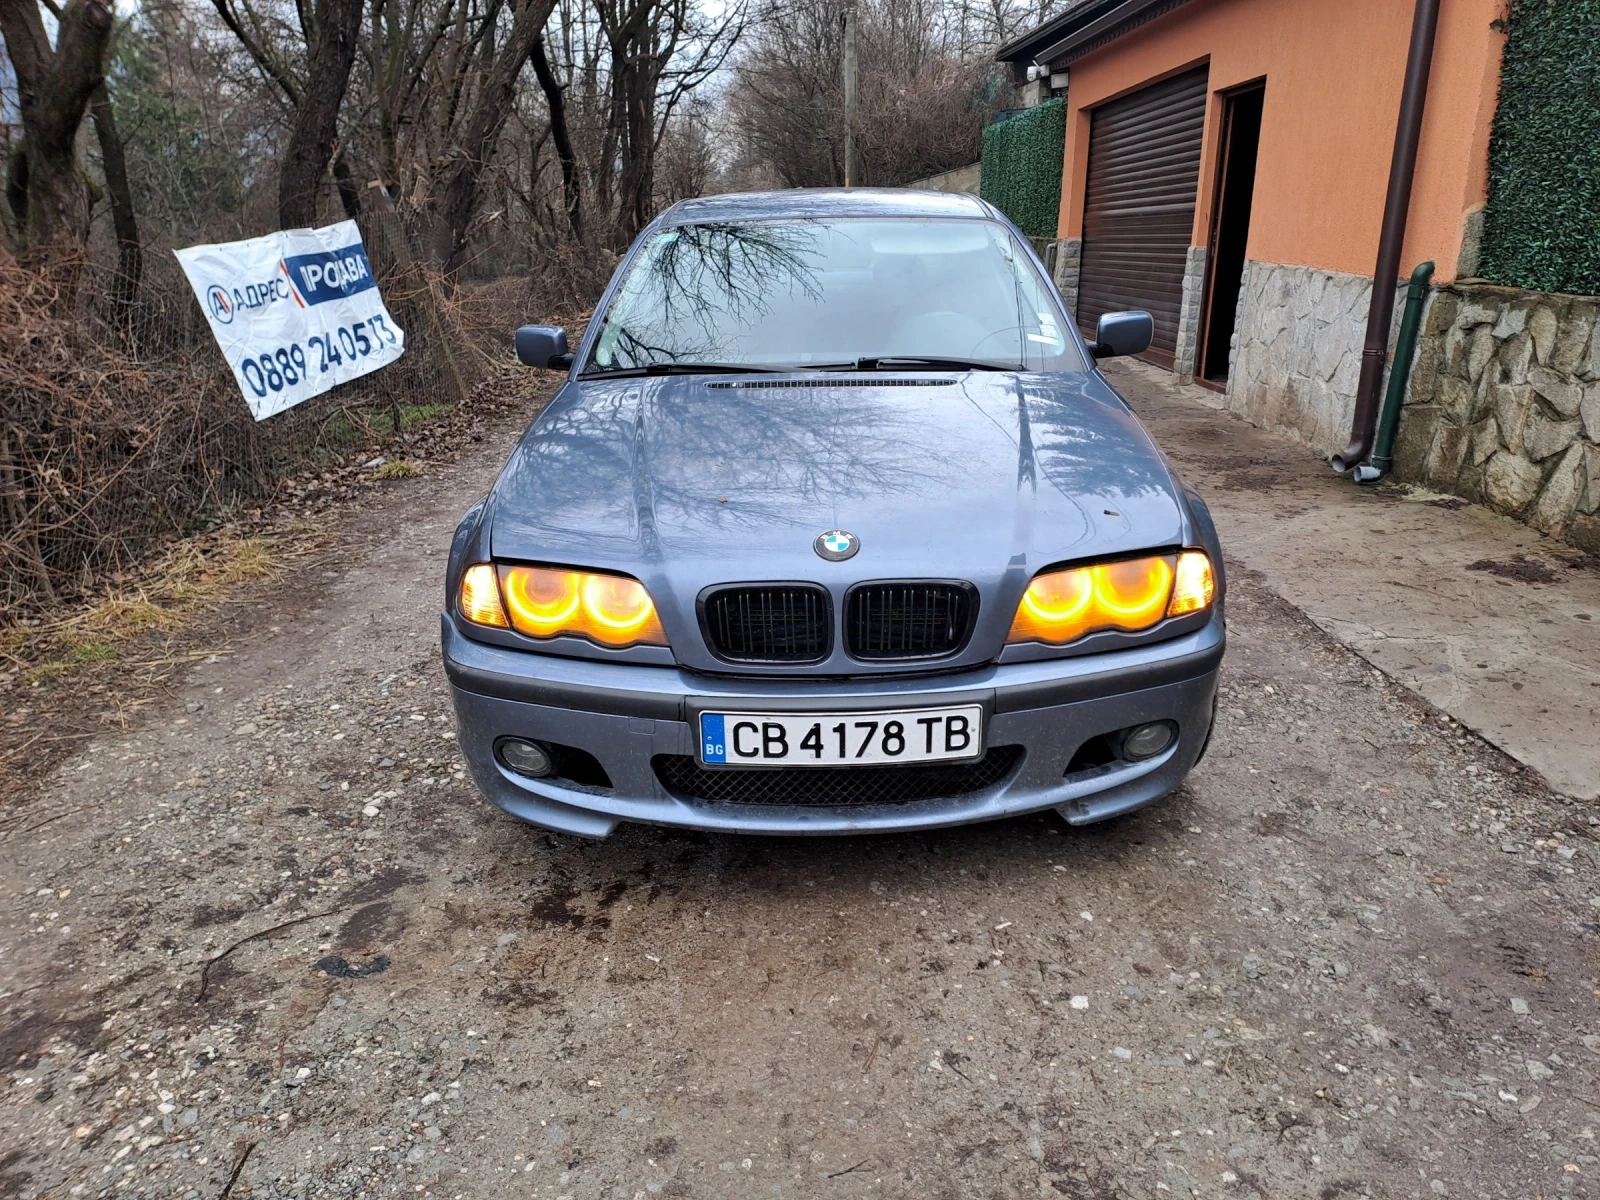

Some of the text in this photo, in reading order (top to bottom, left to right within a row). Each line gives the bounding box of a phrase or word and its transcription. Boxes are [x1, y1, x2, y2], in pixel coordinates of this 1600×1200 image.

[233, 278, 289, 311] АДРЕС
[241, 343, 307, 398] 0889
[705, 743, 724, 756] BG
[732, 715, 971, 759] CB 4178 TB
